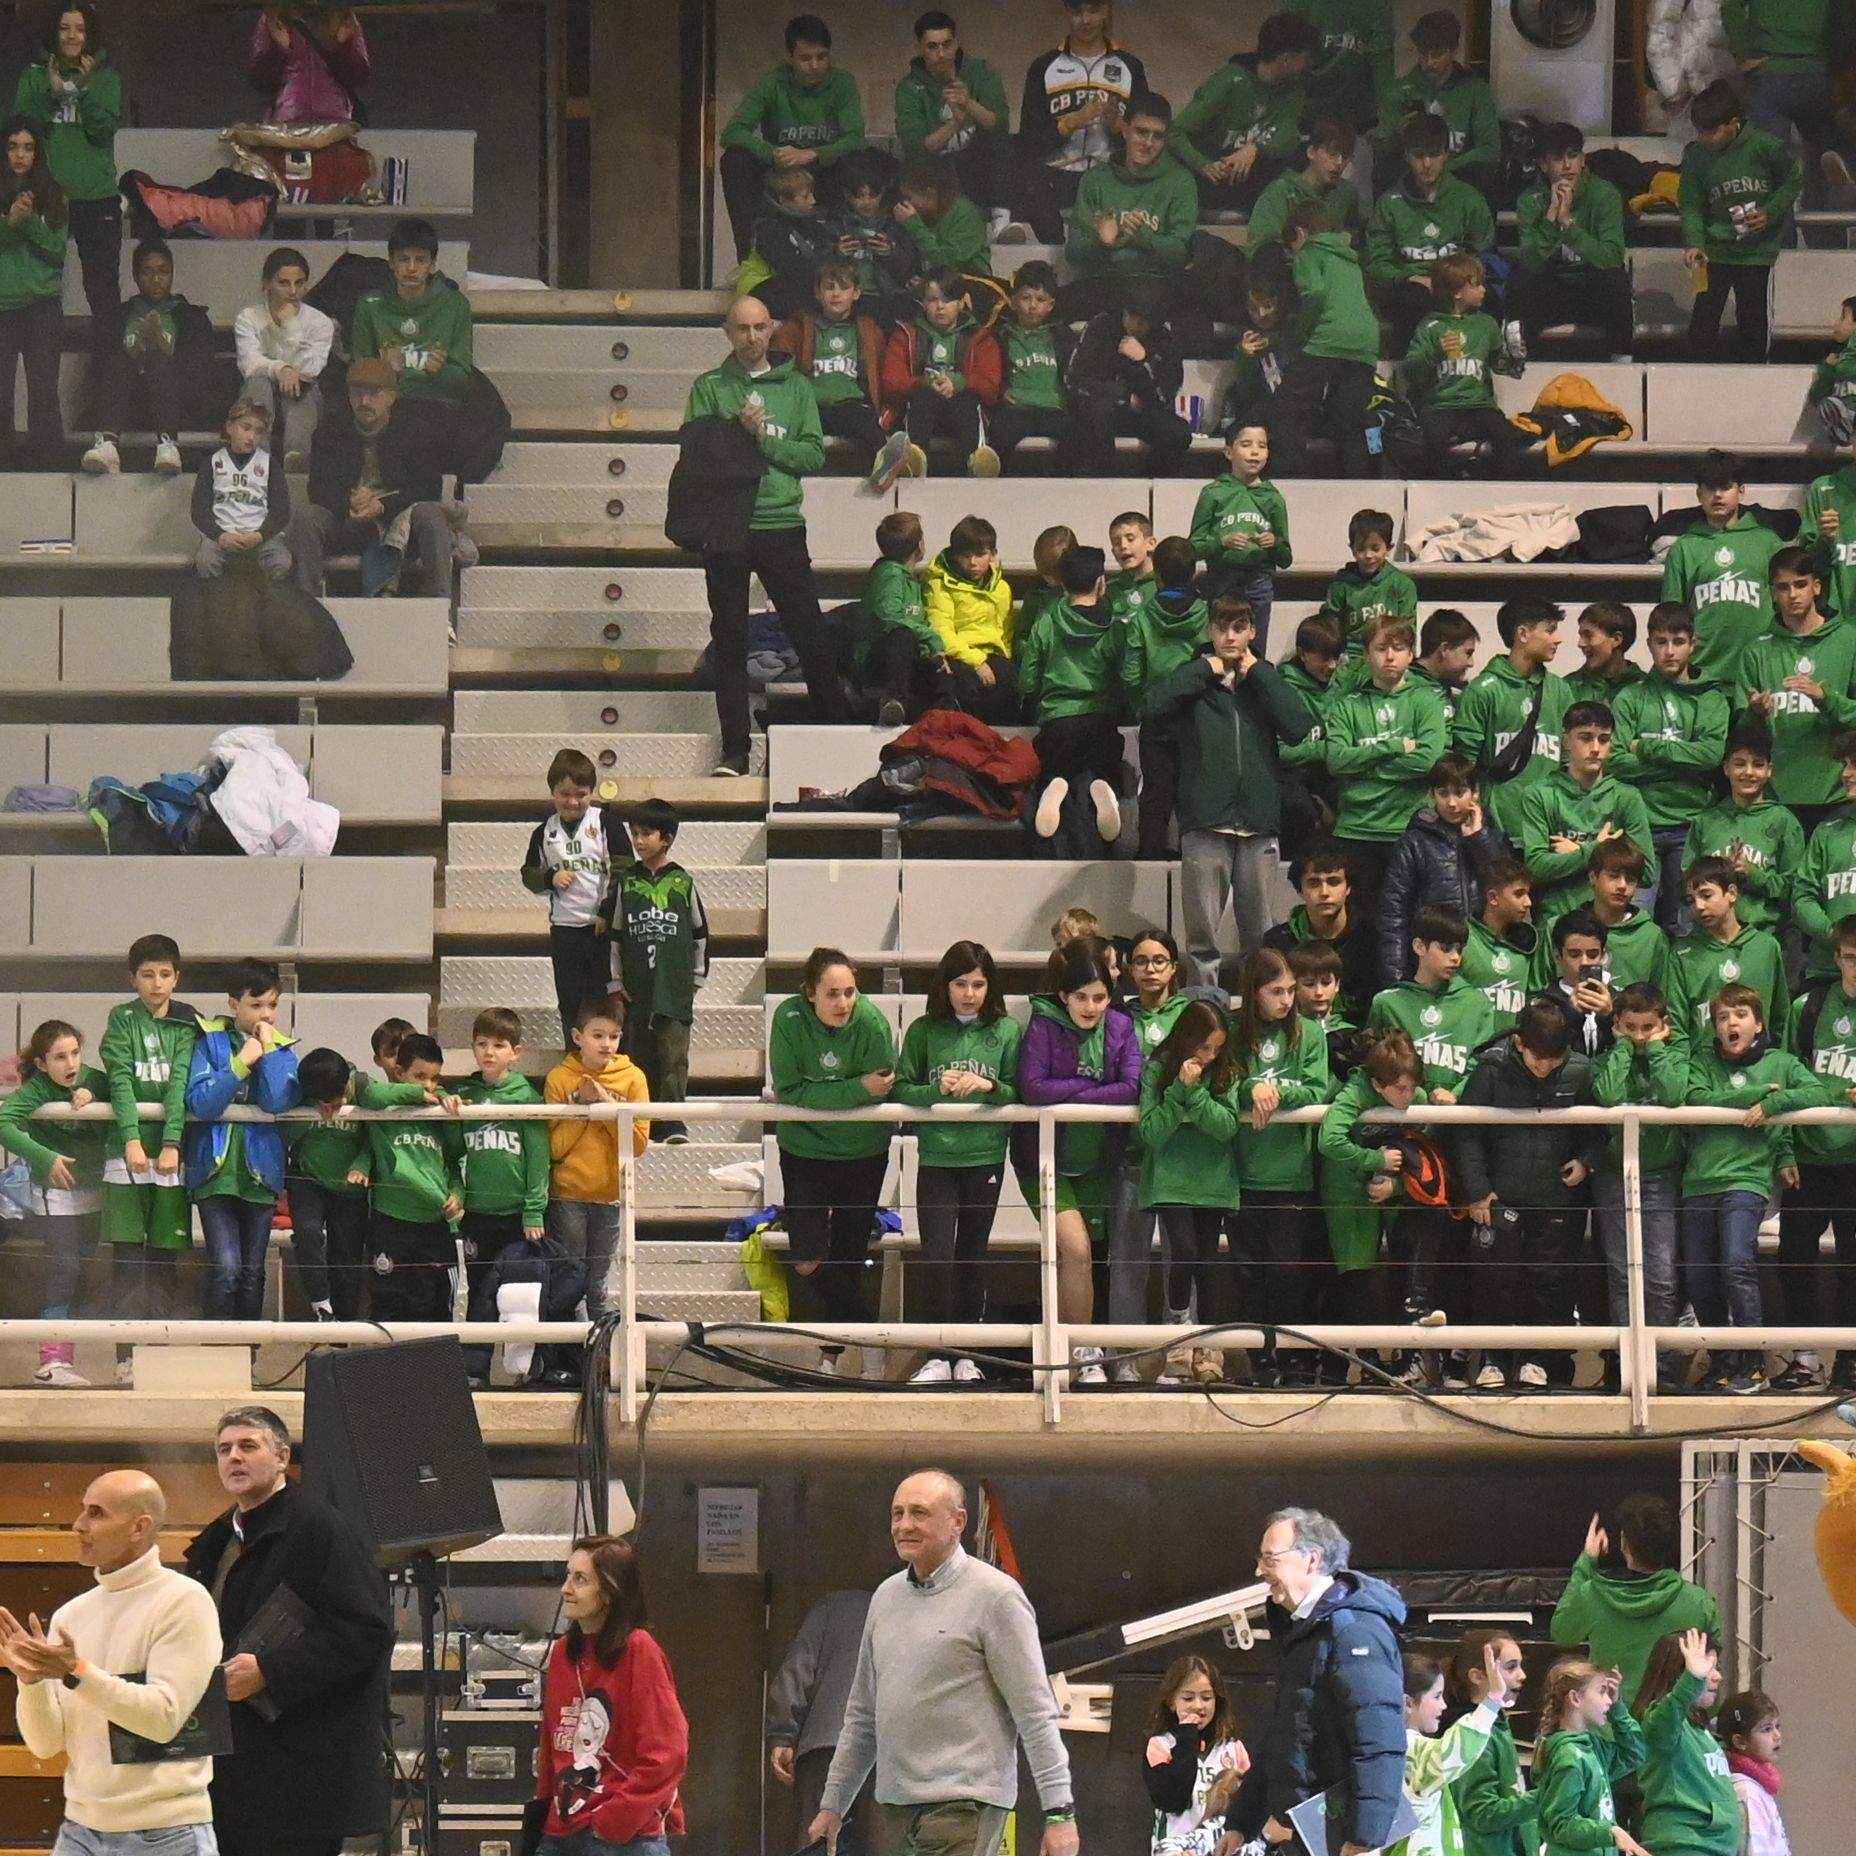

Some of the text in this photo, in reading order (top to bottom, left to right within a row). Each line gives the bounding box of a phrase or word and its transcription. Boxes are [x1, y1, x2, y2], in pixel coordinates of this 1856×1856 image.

[1694, 570, 1761, 610] PEÑAS
[627, 906, 680, 925] Lobe
[647, 944, 657, 970] 2
[394, 1133, 411, 1146] CB
[1198, 1767, 1216, 1784] 15
